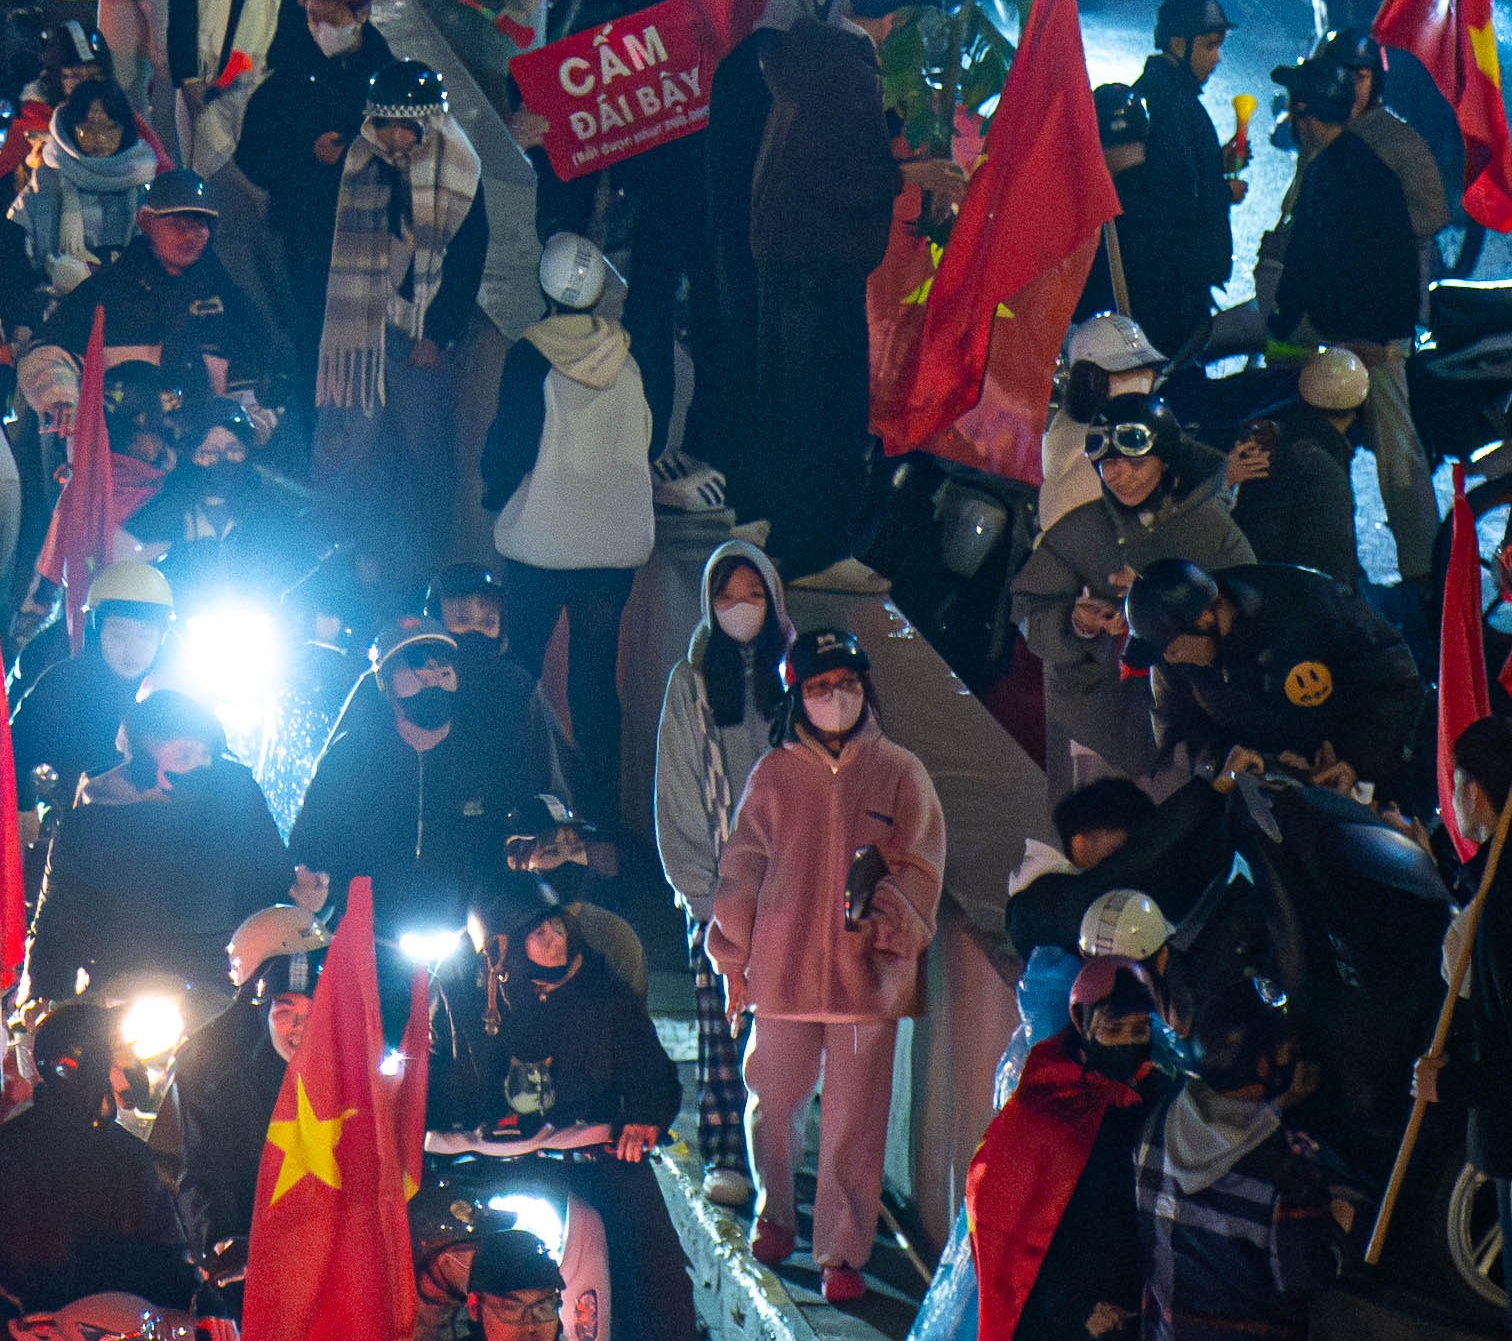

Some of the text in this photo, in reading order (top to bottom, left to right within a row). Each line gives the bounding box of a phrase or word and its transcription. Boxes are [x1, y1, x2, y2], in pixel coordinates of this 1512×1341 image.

[559, 23, 668, 97] CẤM
[569, 93, 634, 141] ĐÁI
[635, 65, 701, 116] BẬY
